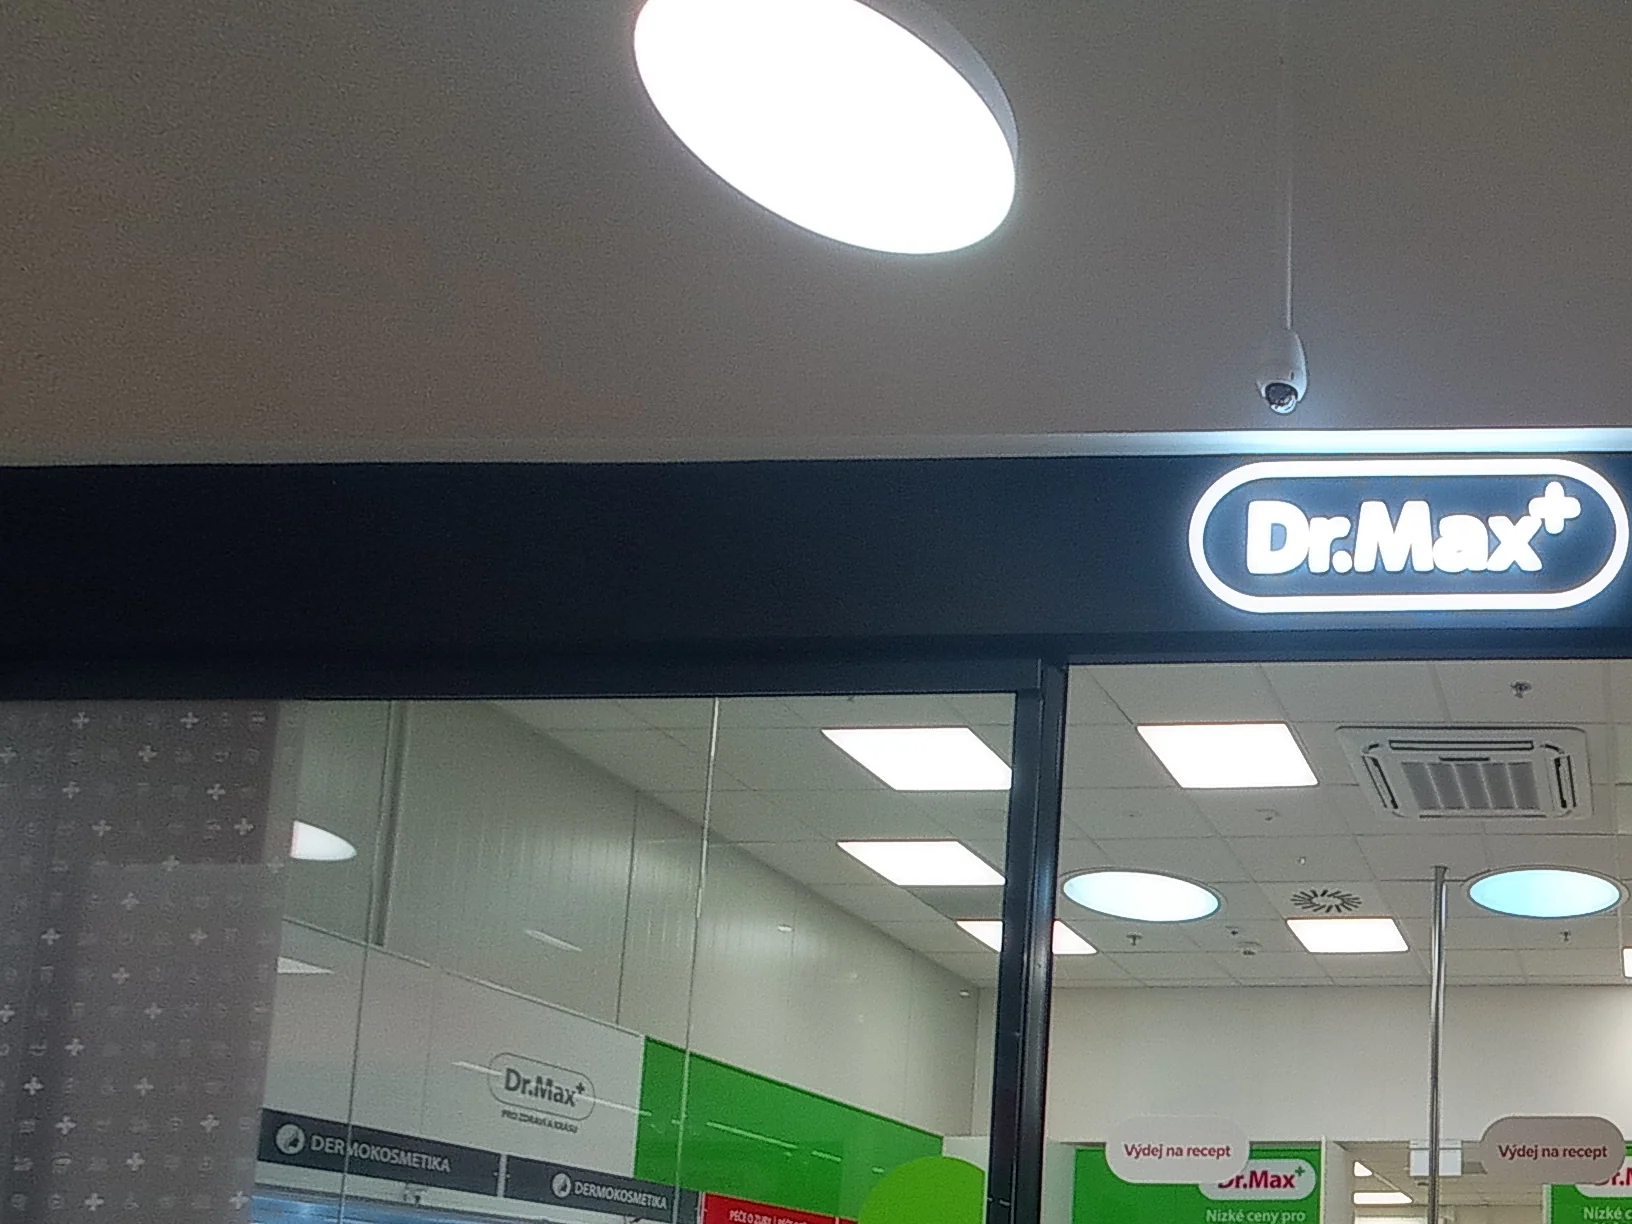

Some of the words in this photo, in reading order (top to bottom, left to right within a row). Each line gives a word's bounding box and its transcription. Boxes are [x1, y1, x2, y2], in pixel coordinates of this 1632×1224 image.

[310, 1134, 451, 1173] DERMOKOSMETIKA
[1123, 1143, 1164, 1161] Výdej
[1166, 1146, 1184, 1158] na
[1186, 1144, 1231, 1160] recept
[1498, 1143, 1539, 1162] Výdej
[1542, 1147, 1560, 1159] na
[1562, 1145, 1608, 1161] recept
[574, 1181, 668, 1210] DERMOKOSMETIKA
[1206, 1208, 1245, 1223] Nízké
[1247, 1210, 1280, 1224] ceny
[1281, 1211, 1306, 1224] pro
[1583, 1206, 1622, 1220] Nízké
